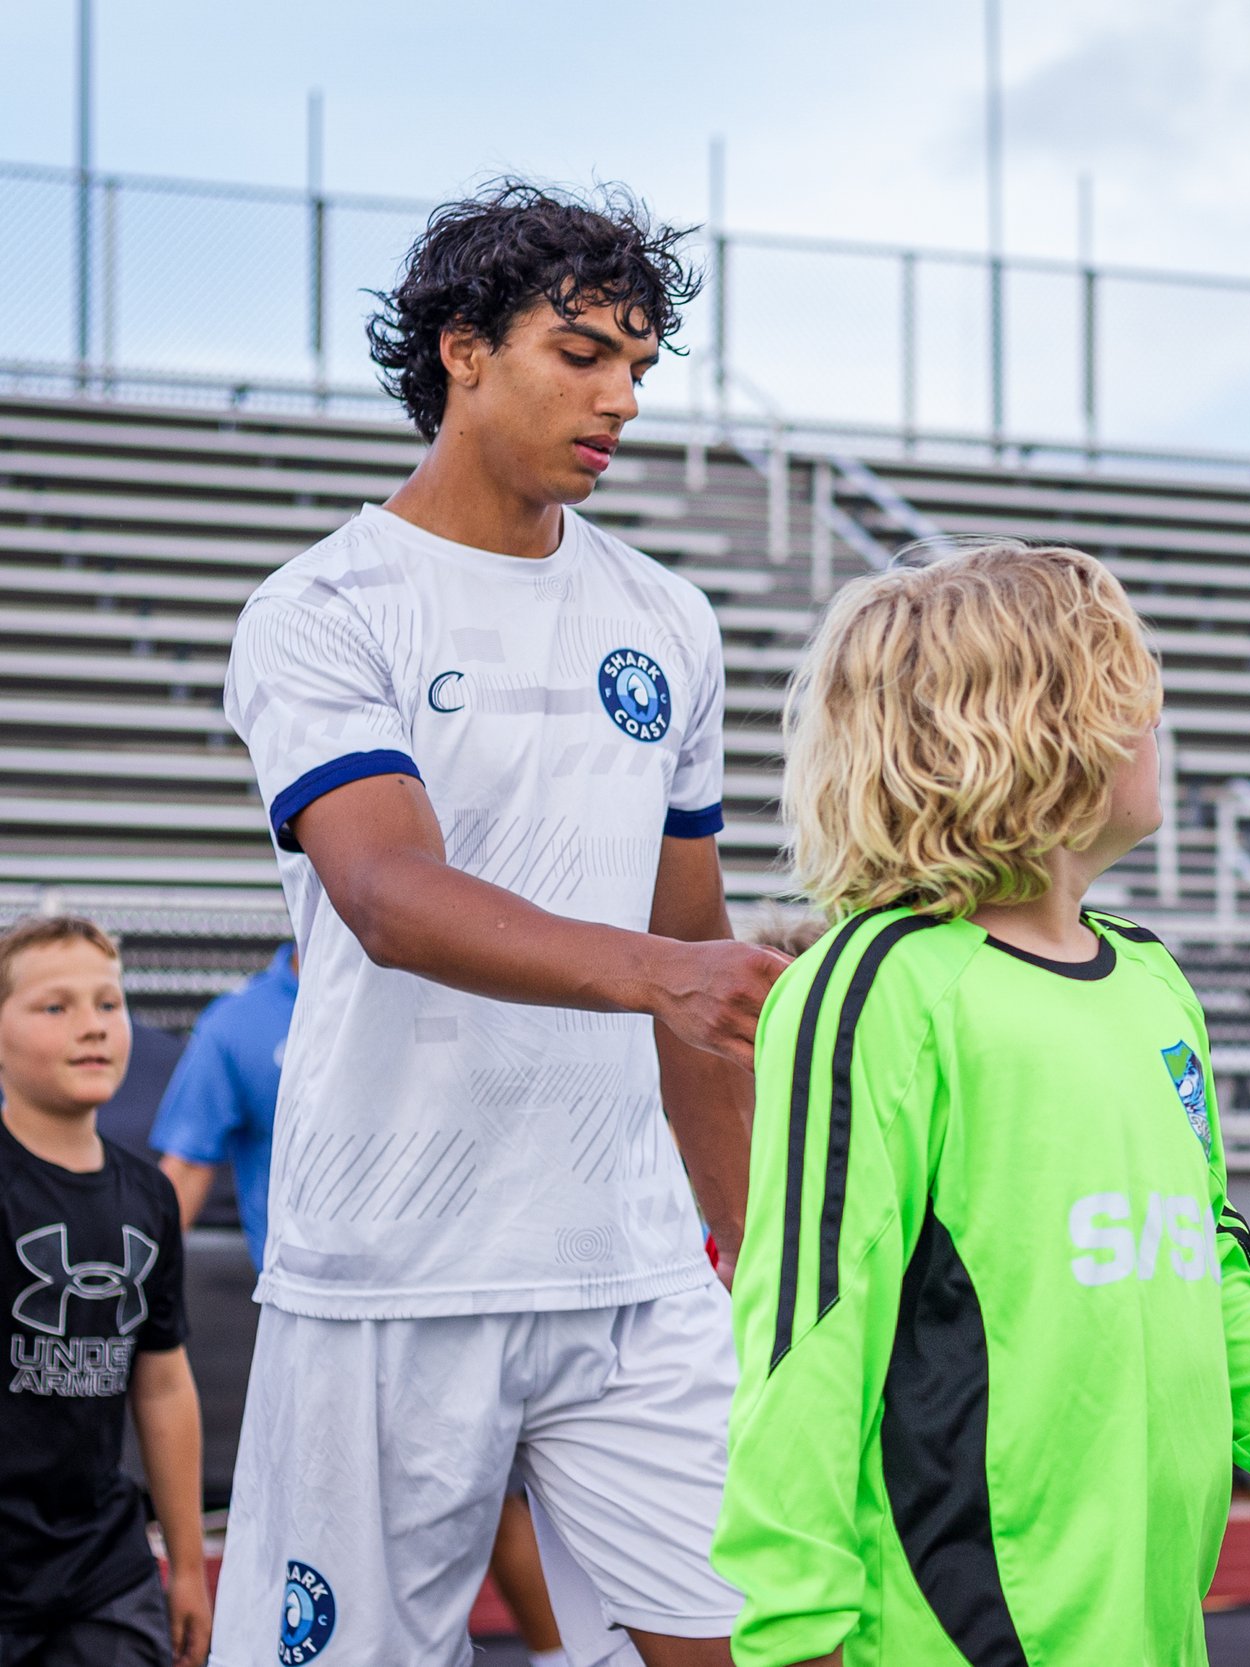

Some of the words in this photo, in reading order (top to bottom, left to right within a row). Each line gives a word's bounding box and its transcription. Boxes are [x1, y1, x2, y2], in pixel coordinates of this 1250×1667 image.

[604, 651, 661, 681] SHARK
[660, 693, 667, 704] C
[614, 709, 666, 740] COAST
[10, 1333, 137, 1373] UNDE
[286, 1565, 328, 1601] ARK
[317, 1614, 328, 1626] C
